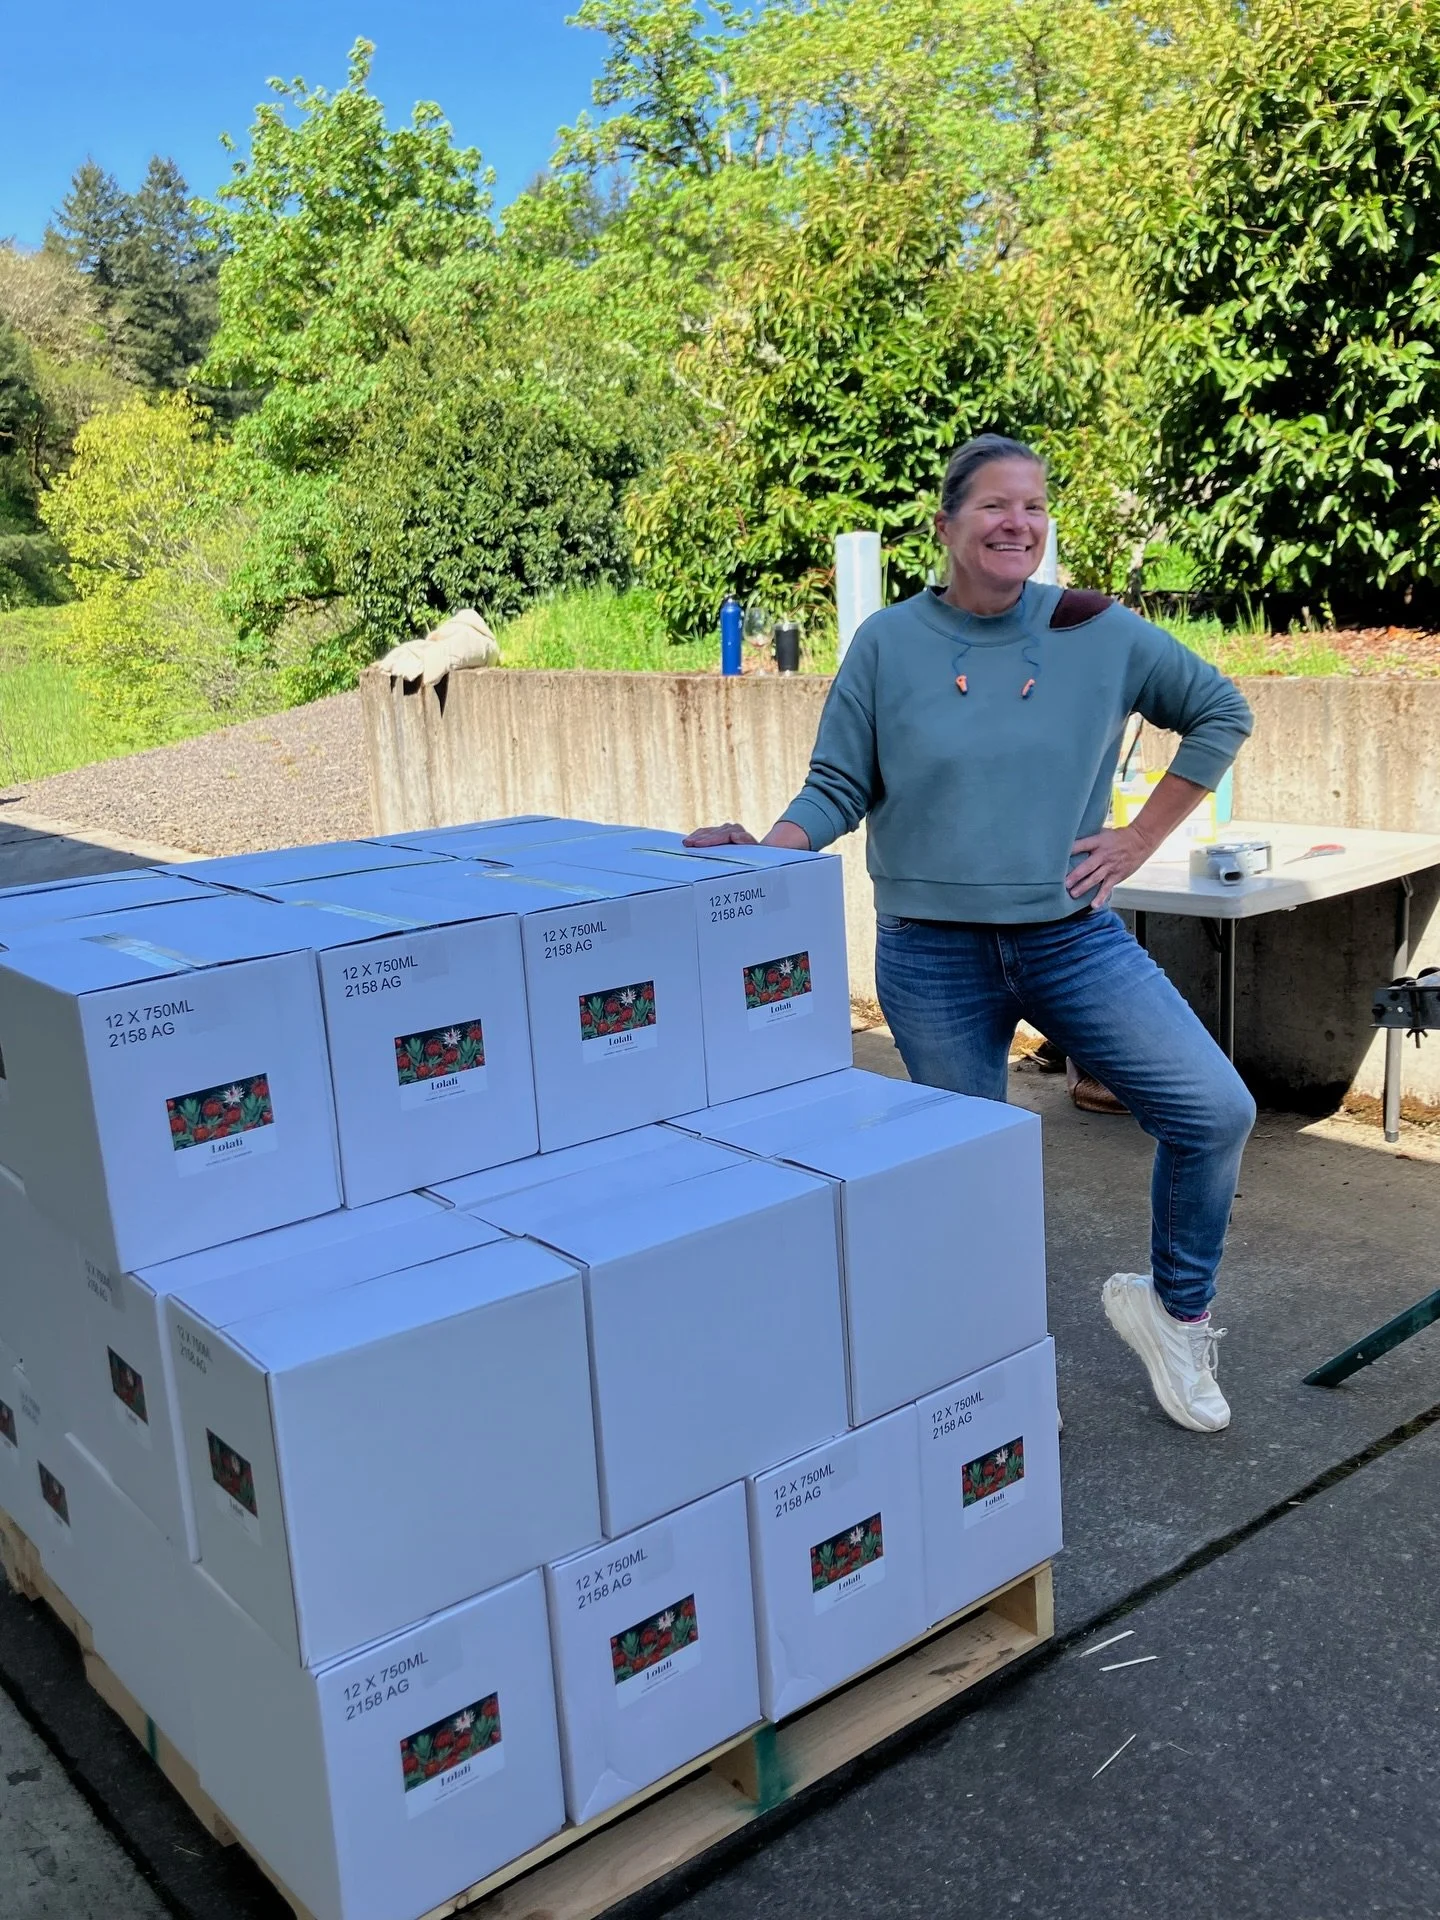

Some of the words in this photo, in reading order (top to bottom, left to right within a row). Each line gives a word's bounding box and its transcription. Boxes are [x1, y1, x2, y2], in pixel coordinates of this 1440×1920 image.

[709, 896, 721, 907] 12
[724, 894, 731, 905] X
[734, 887, 766, 903] 750ML
[711, 908, 736, 922] 2158
[737, 905, 753, 917] AG
[543, 931, 556, 942] 12
[560, 928, 568, 940] X
[571, 921, 607, 937] 750ML
[545, 943, 572, 959] 2158
[575, 939, 593, 953] AG
[343, 967, 358, 980] 12
[362, 964, 372, 977] X
[375, 955, 418, 974] 750ML
[345, 980, 377, 997] 2158
[381, 975, 401, 990] AG
[105, 1013, 123, 1028] 12
[128, 1009, 140, 1024] X
[144, 1000, 194, 1021] 750ML
[109, 1027, 147, 1047] 2158
[151, 1022, 175, 1039] AG
[431, 1077, 458, 1090] Lolali
[931, 1410, 943, 1424] 12
[945, 1405, 952, 1419] X
[954, 1391, 985, 1413] 750ML
[933, 1420, 956, 1440] 2158
[958, 1411, 973, 1428] AG
[774, 1485, 786, 1500] 12
[790, 1480, 798, 1494] X
[800, 1463, 835, 1488] 750ML
[775, 1495, 802, 1518] 2158
[804, 1486, 822, 1504] AG
[575, 1575, 590, 1591] 12
[594, 1568, 603, 1583] X
[607, 1548, 649, 1576] 750ML
[578, 1585, 609, 1610] 2158
[612, 1572, 632, 1593] AG
[343, 1683, 361, 1701] 12
[365, 1675, 377, 1691] X
[380, 1652, 429, 1682] 750ML
[346, 1692, 383, 1721] 2158
[387, 1679, 409, 1700] AG
